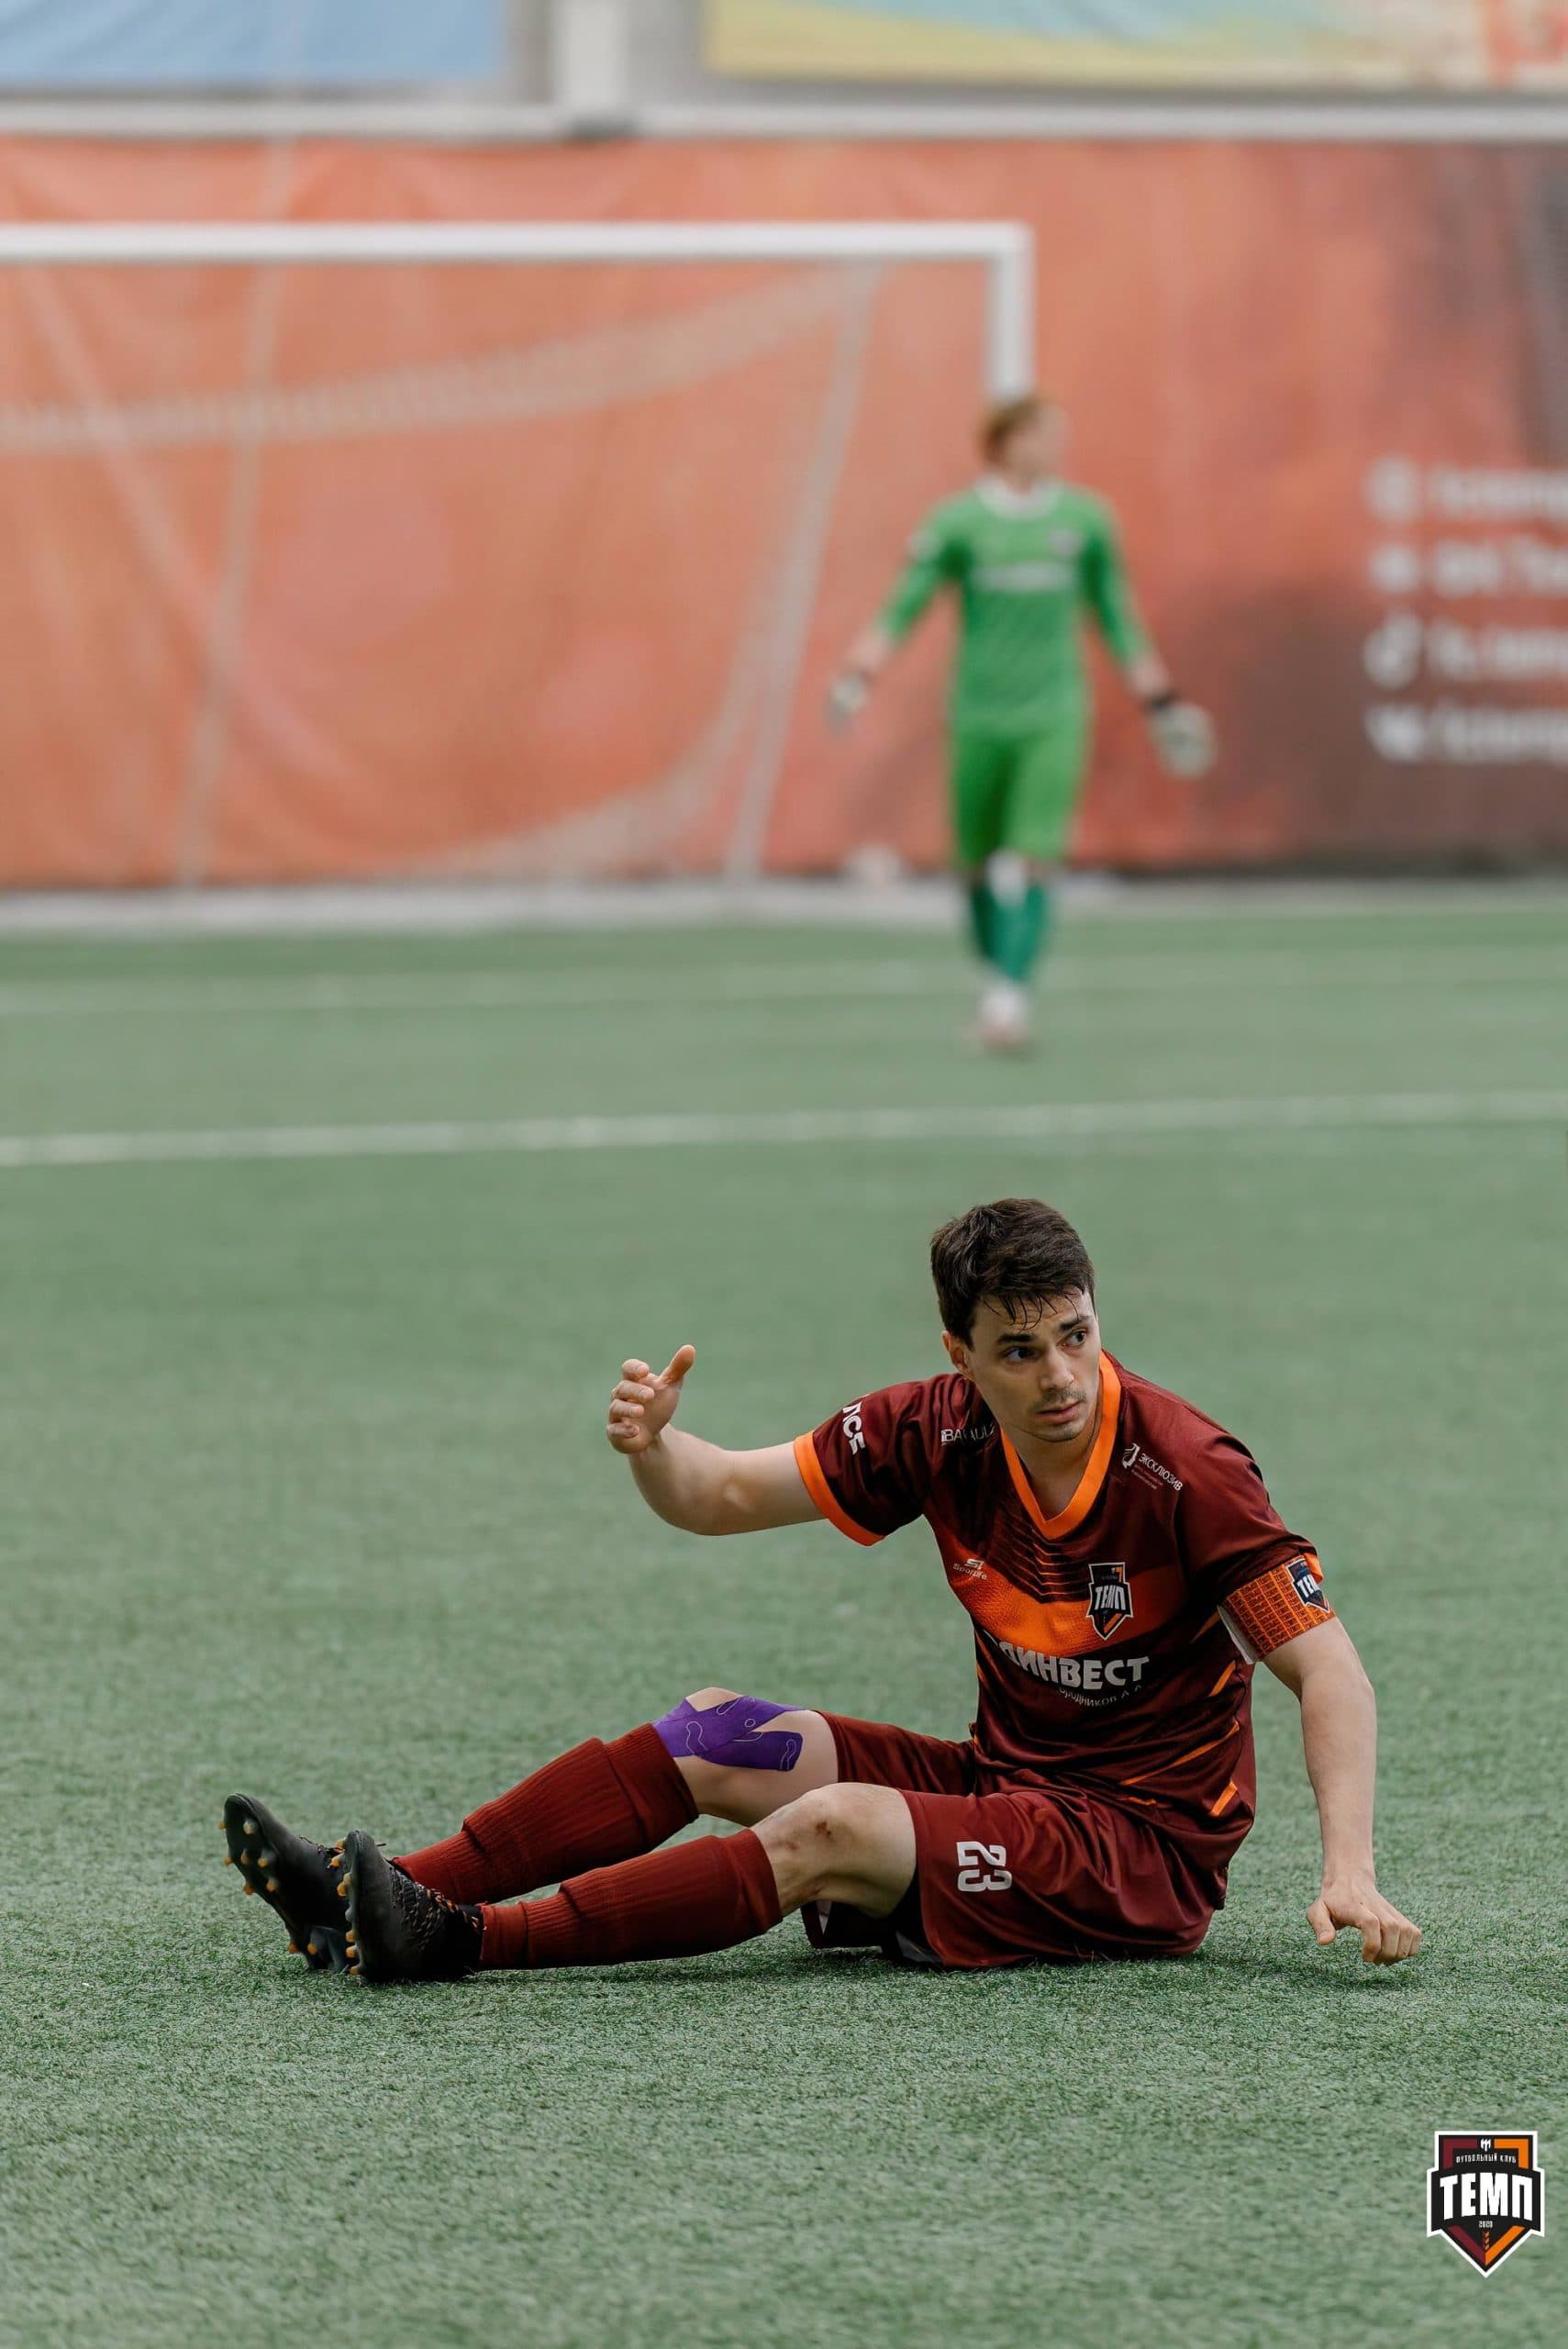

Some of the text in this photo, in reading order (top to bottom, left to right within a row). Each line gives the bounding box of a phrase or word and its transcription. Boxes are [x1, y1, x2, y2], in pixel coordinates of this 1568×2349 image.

[1138, 1453, 1184, 1491] ЭКСКЛЮЗИВ
[1094, 1585, 1127, 1611] ТЕМП
[956, 1841, 1012, 1892] 23
